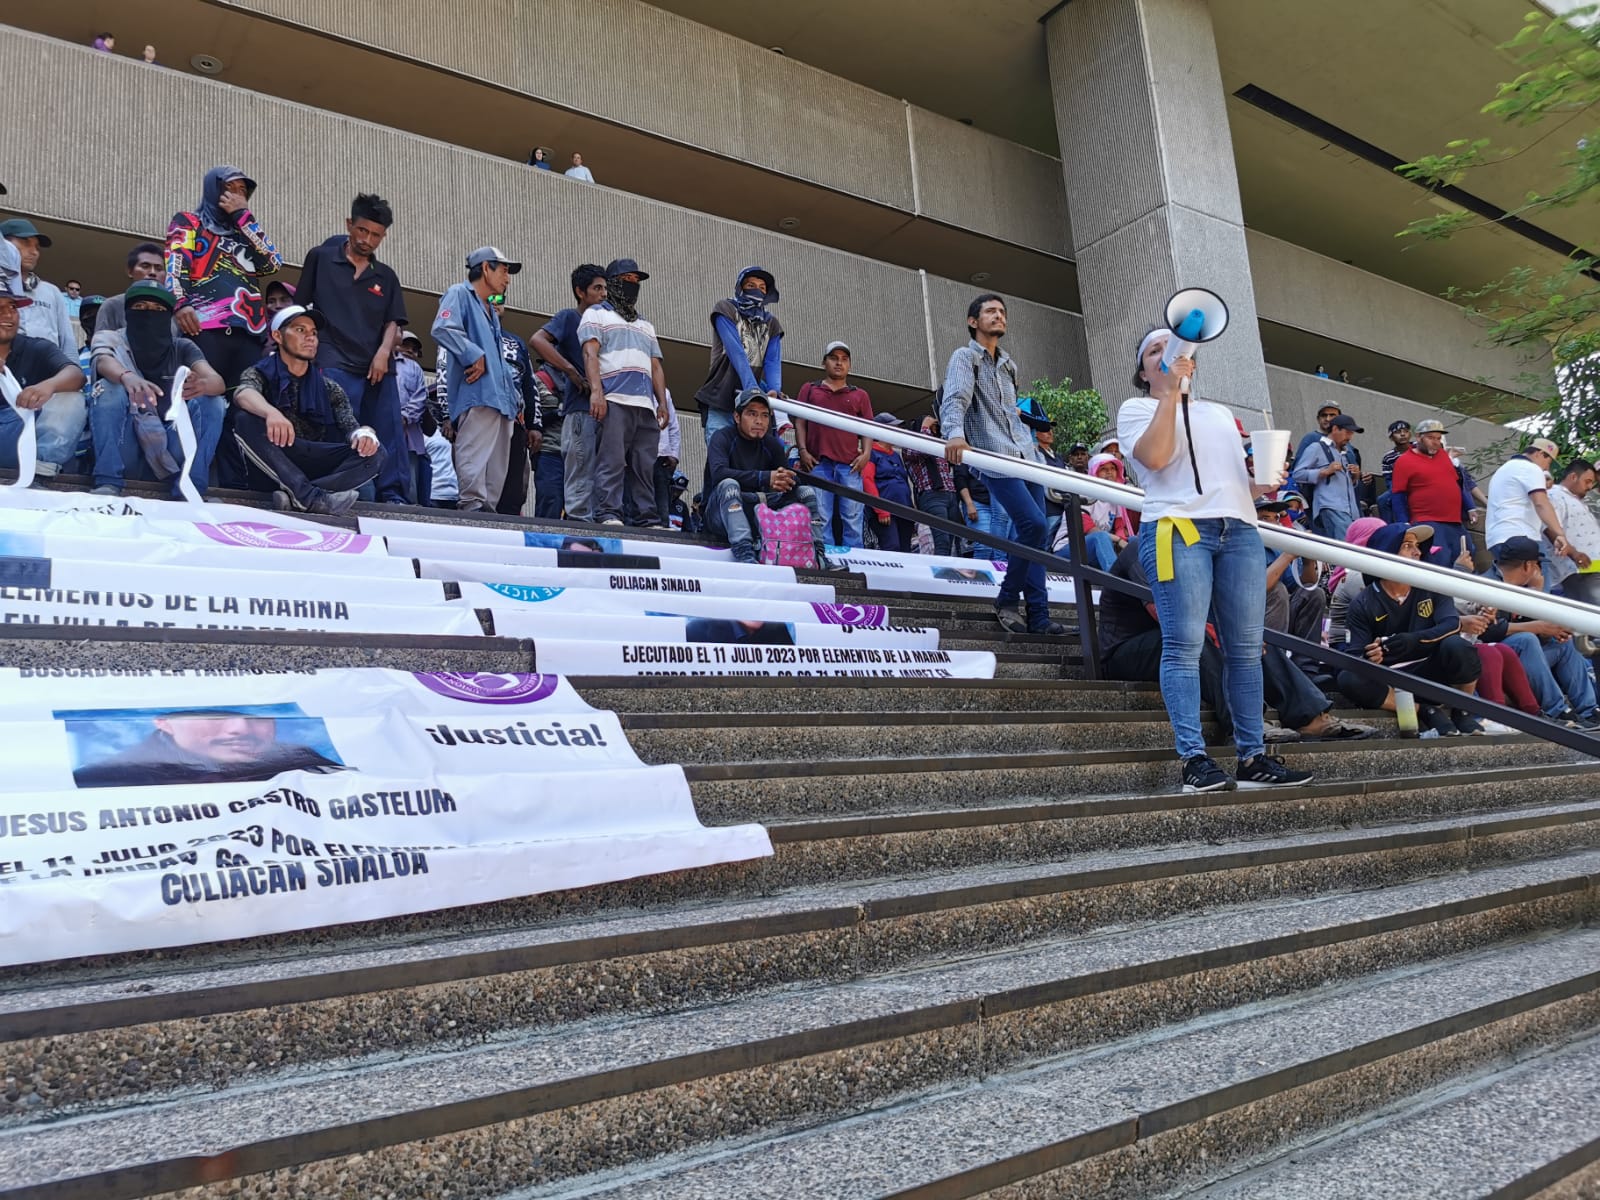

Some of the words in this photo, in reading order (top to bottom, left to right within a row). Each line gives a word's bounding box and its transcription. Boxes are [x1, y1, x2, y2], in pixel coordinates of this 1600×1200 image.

[610, 575, 659, 591] CULIACAN
[661, 577, 702, 593] SINALOA
[165, 595, 197, 612] DE
[208, 596, 239, 614] LA
[249, 598, 349, 620] MARINA
[623, 645, 693, 663] EJECUTADO
[697, 647, 711, 663] EL
[715, 647, 727, 663] 11
[731, 647, 764, 664] JULIO
[767, 648, 797, 664] 2023
[799, 648, 821, 664] POR
[823, 648, 882, 664] ELEMENTOS
[884, 649, 898, 664] DE
[898, 649, 912, 664] LA
[913, 648, 952, 664] MARINA
[0, 811, 88, 838] JESUS
[99, 802, 220, 830] ANTONIO
[228, 788, 321, 817] CASTRO
[329, 788, 457, 820] GASTELUM
[92, 843, 178, 864] JULIO
[271, 827, 320, 857] POR
[161, 860, 307, 905] CULIACAN
[315, 850, 429, 888] SINALOA
